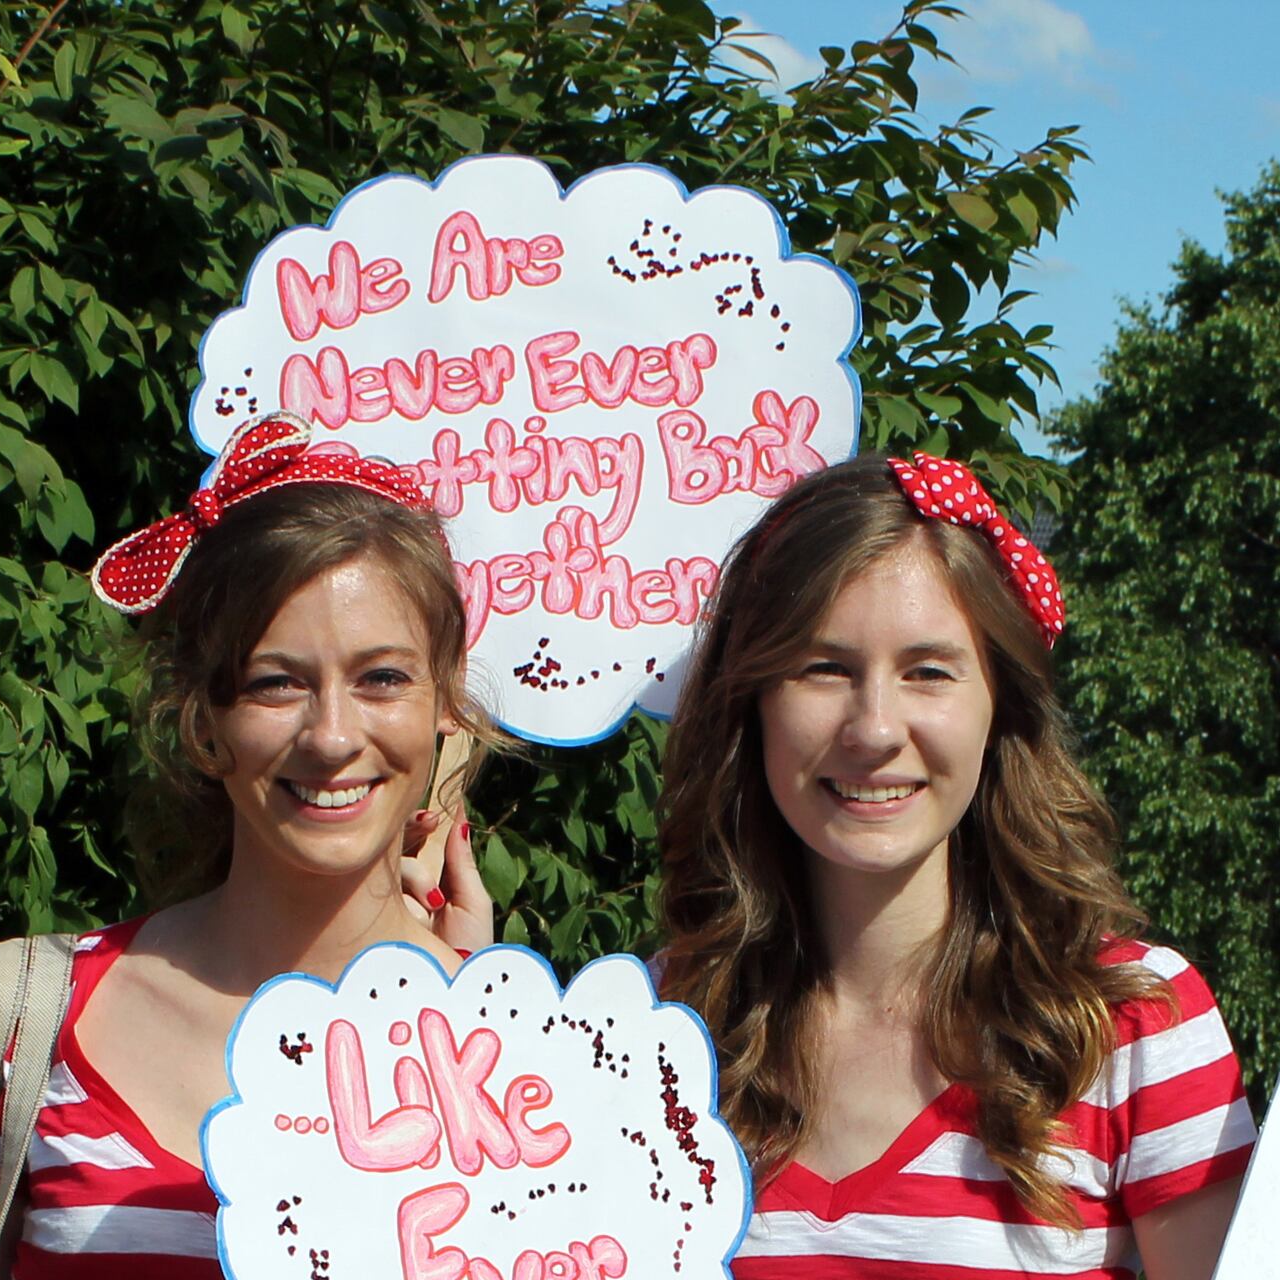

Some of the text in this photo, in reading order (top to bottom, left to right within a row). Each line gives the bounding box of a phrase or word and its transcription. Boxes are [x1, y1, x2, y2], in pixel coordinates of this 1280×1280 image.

[276, 211, 565, 342] We Are
[279, 331, 718, 431] Never Ever
[306, 389, 828, 547] tting Back
